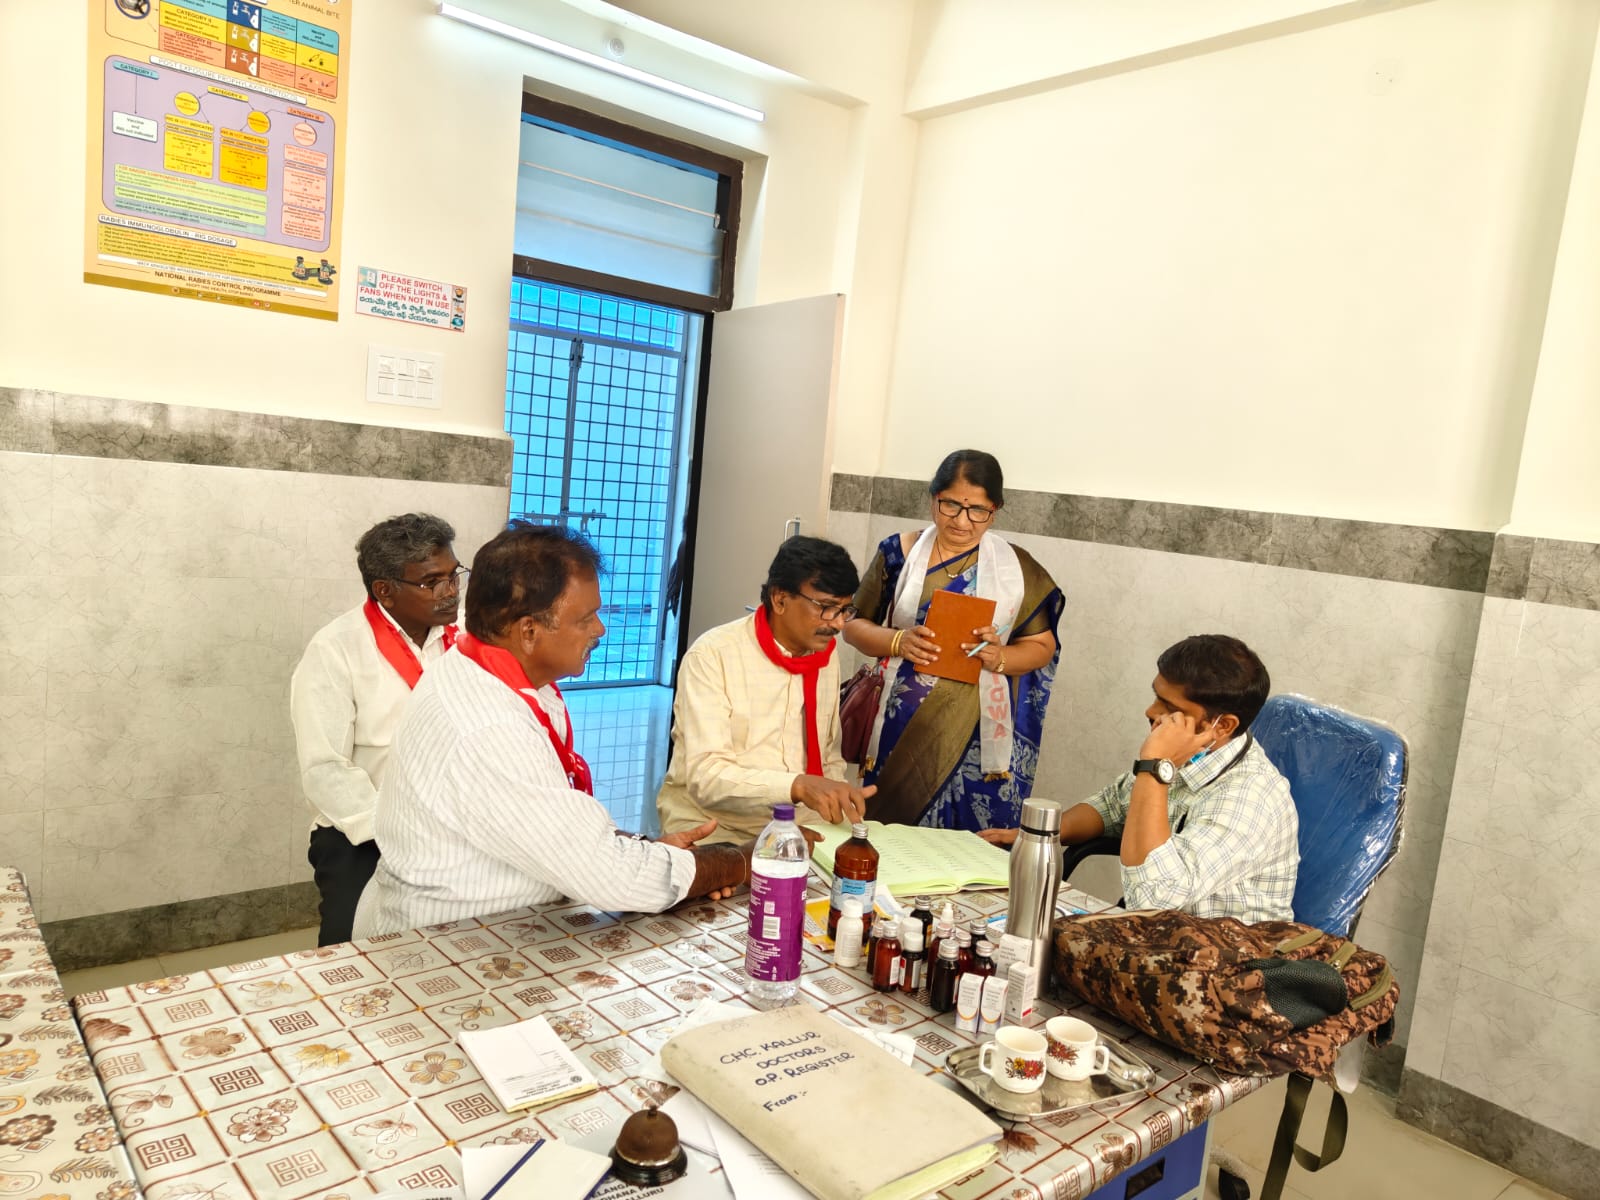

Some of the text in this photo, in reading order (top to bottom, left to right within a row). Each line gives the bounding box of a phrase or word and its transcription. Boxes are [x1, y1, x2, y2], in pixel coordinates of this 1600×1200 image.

[100, 215, 126, 225] RABIES
[127, 219, 190, 238] IMMUNOGLOBULIN
[207, 235, 234, 246] DOSAGE
[154, 270, 187, 281] NATIONAL
[188, 276, 211, 286] RABIES
[211, 280, 241, 291] CONTROL
[242, 285, 282, 297] PROGRAMME
[379, 281, 395, 291] OFF
[397, 285, 412, 294] THE
[413, 288, 441, 301] LIGHTS
[442, 293, 448, 301] &
[381, 273, 443, 292] PLEASE SWITCH
[360, 286, 381, 297] FANS
[383, 291, 407, 302] WHEN
[408, 295, 424, 305] NOT
[426, 299, 434, 307] IN
[435, 300, 450, 310] USE
[760, 1031, 822, 1053] KALLUR
[756, 1045, 827, 1070] DOCTORS
[783, 1051, 856, 1079] REGISTER
[762, 1092, 798, 1113] From
